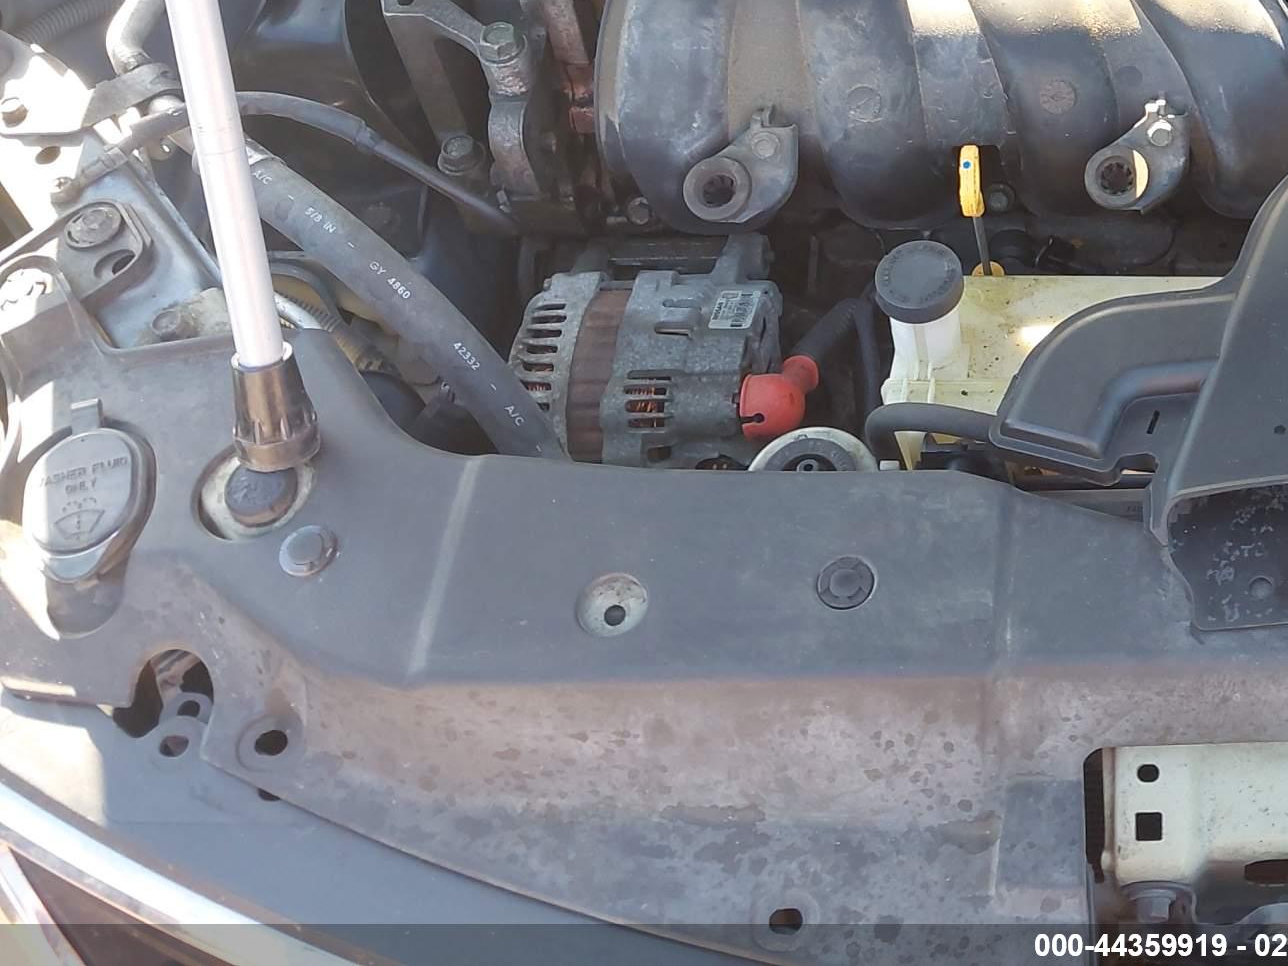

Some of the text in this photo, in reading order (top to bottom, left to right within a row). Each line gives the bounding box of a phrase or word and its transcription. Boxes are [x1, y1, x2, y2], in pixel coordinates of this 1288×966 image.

[304, 206, 323, 223] 5/8
[322, 222, 337, 234] IN
[368, 260, 386, 276] GY
[386, 276, 411, 300] 4860
[452, 341, 481, 371] 42332
[504, 404, 525, 427] A/C
[39, 466, 87, 488] ASHER
